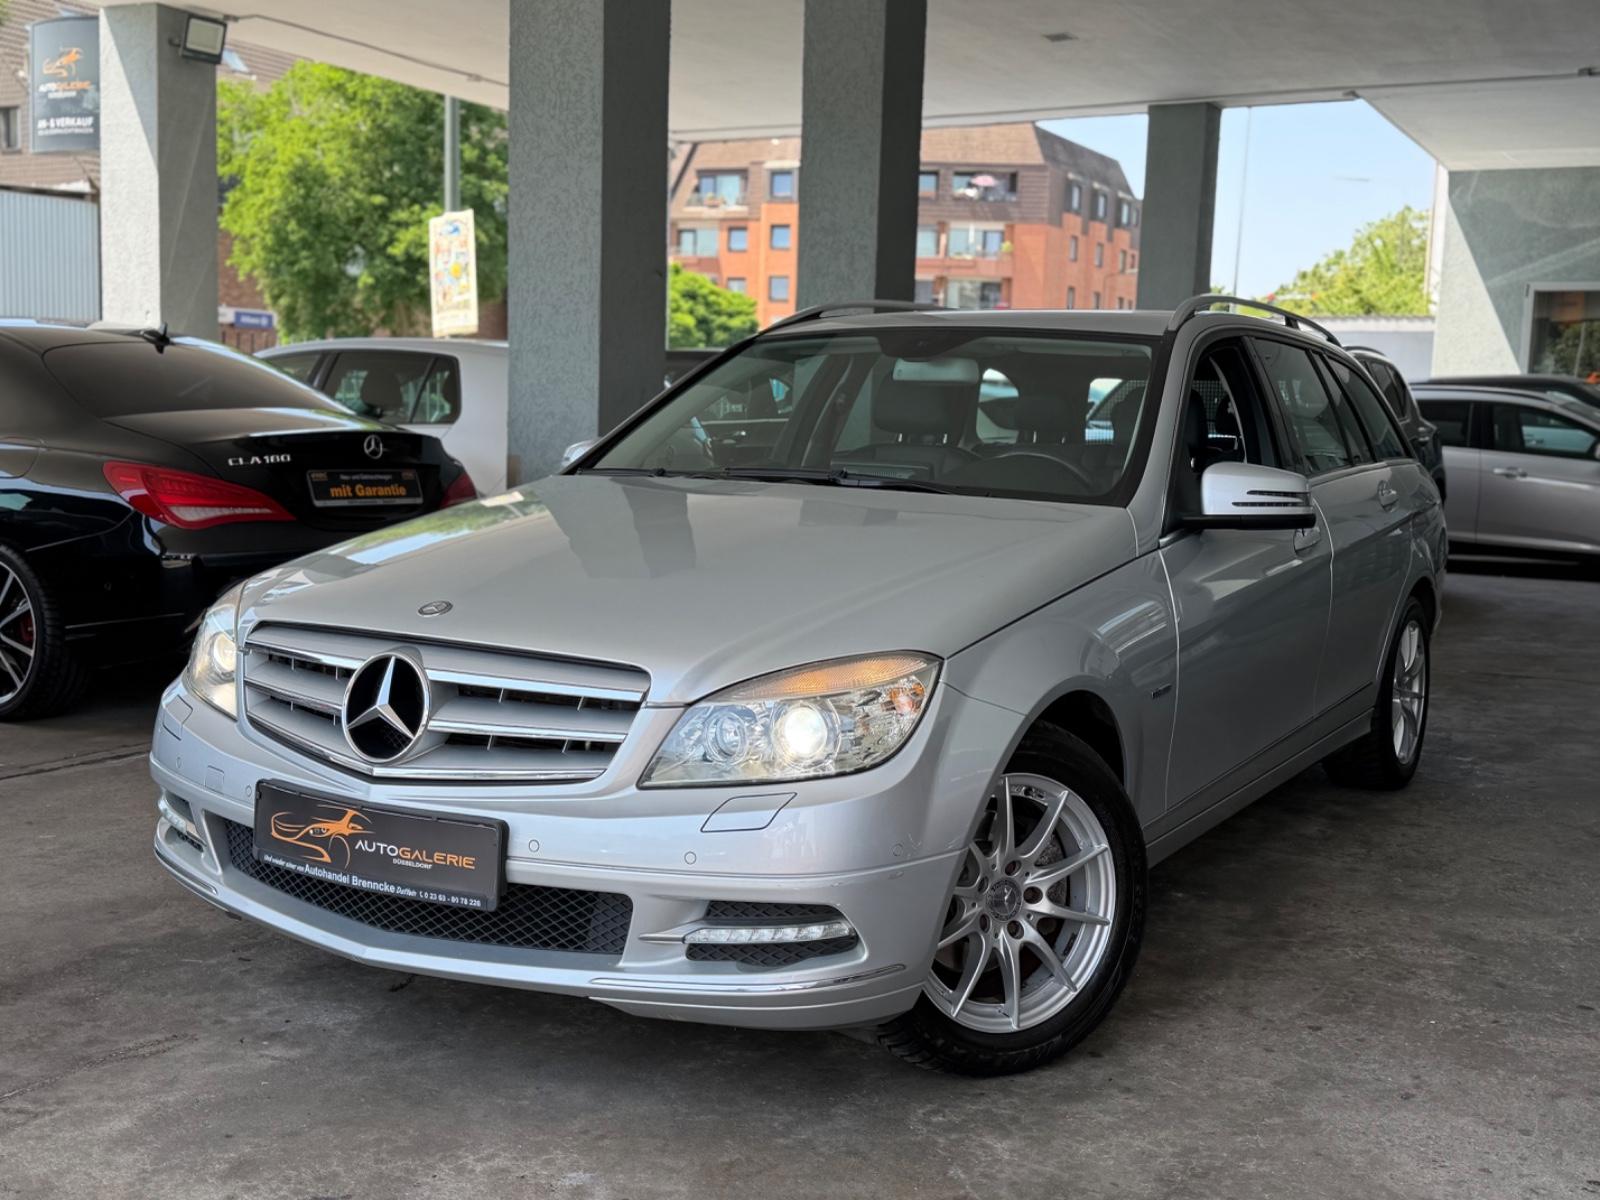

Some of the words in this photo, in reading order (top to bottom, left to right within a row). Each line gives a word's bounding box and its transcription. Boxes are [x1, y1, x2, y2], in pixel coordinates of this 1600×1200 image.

[330, 485, 352, 498] mit
[355, 483, 407, 497] Garantie
[355, 839, 477, 870] AUTOGALERIE
[392, 857, 433, 870] DÜSSELDORF
[304, 863, 350, 884] Autohandel
[351, 875, 396, 893] Brenncke
